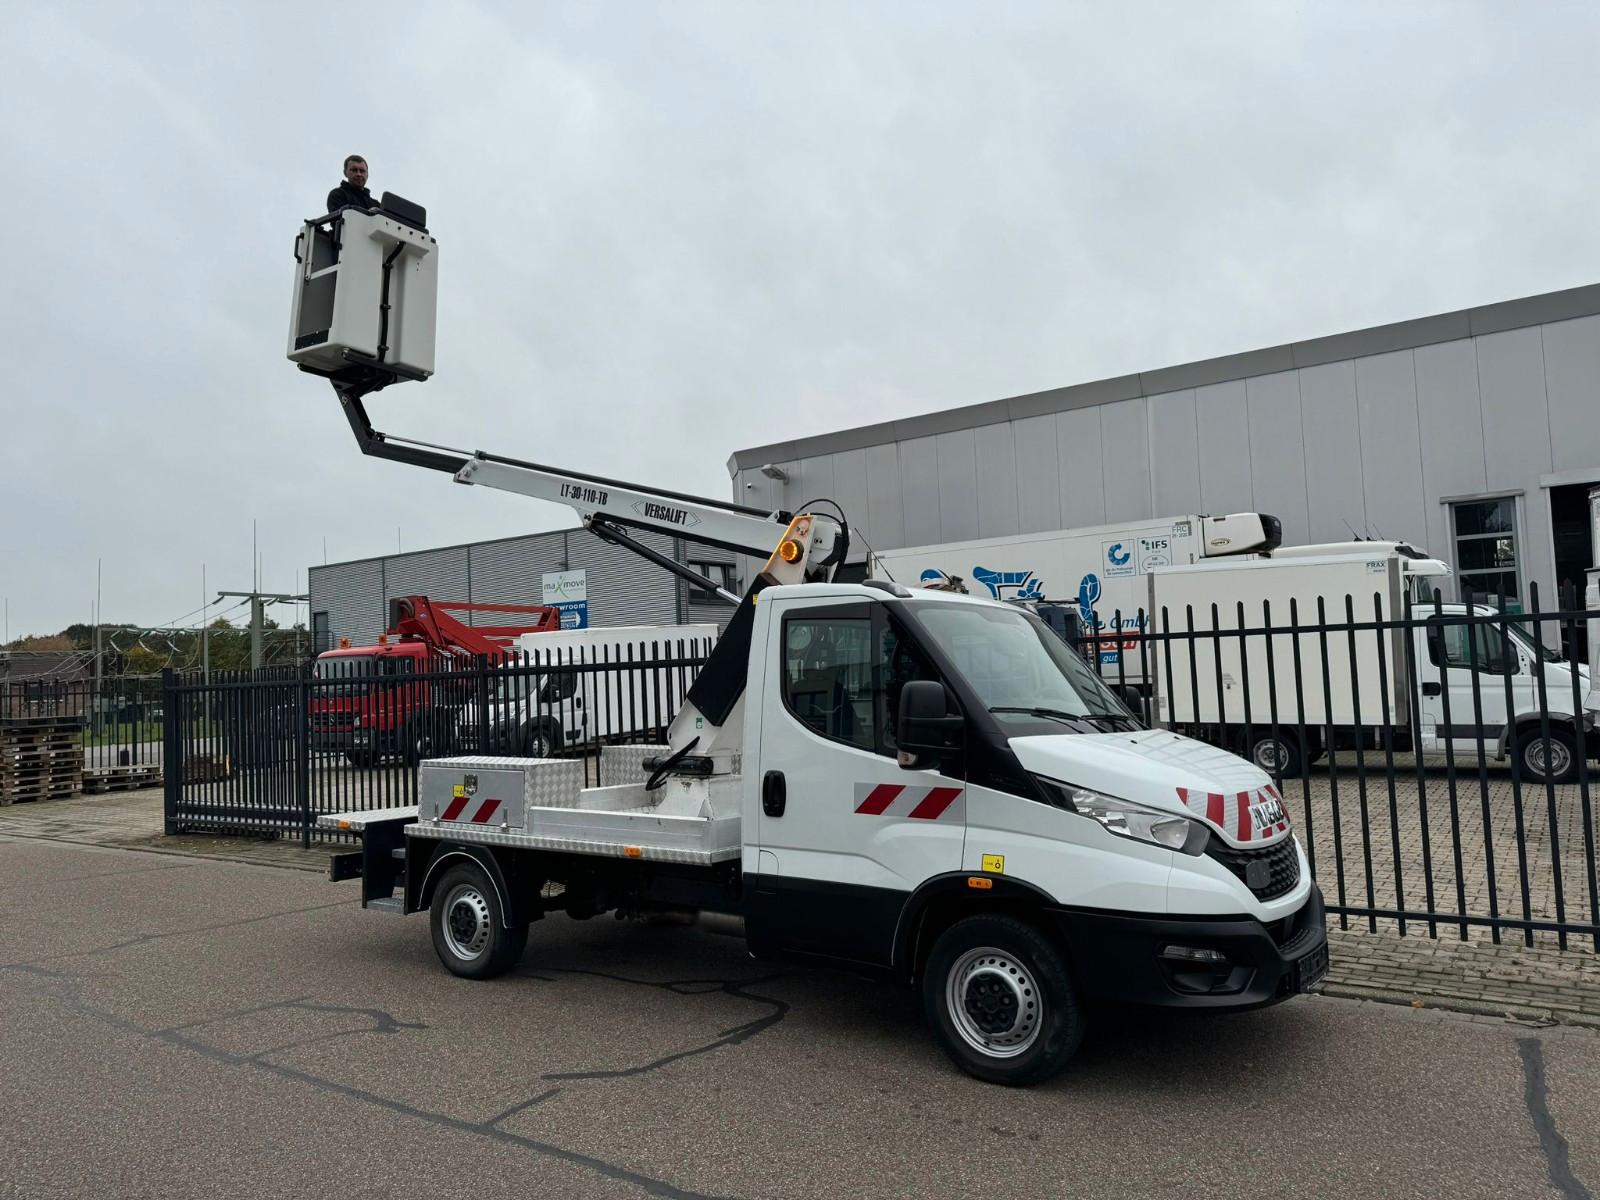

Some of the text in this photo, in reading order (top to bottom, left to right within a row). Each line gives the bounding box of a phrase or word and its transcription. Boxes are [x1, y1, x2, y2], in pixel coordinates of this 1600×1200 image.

[560, 483, 608, 506] LT-30-110-TB
[644, 502, 689, 525] VERSALIFT
[1151, 540, 1168, 550] IFS
